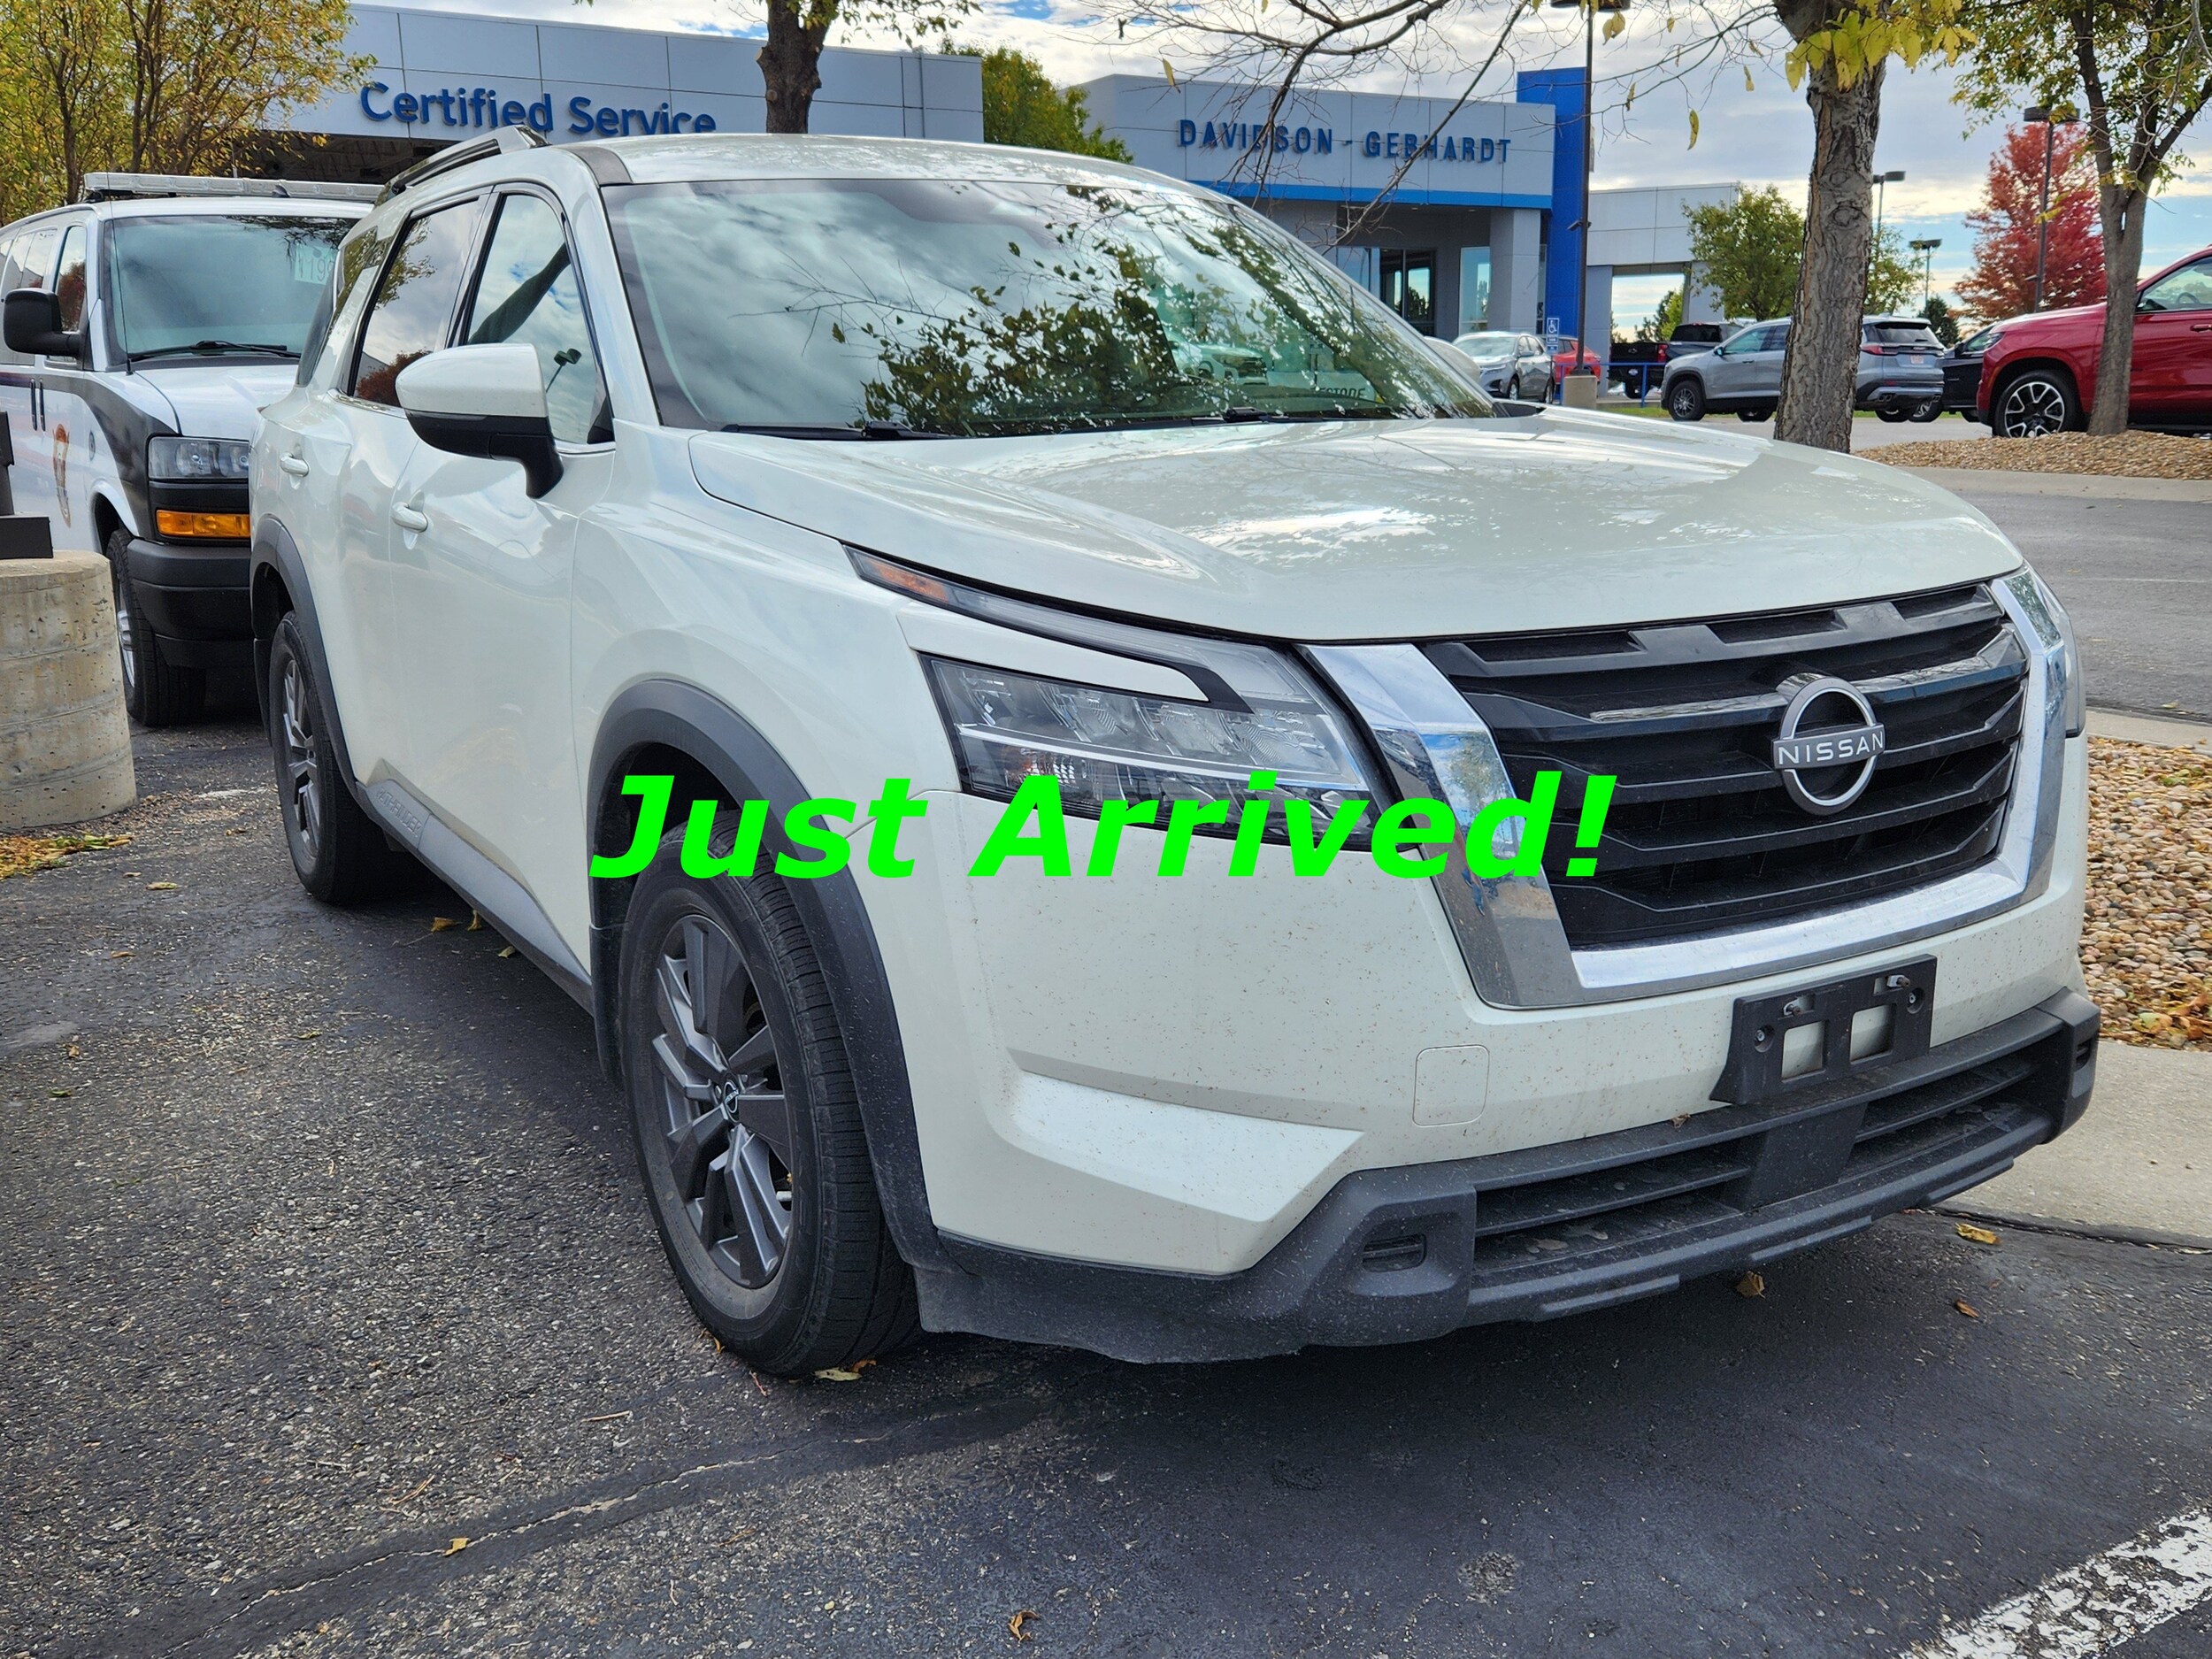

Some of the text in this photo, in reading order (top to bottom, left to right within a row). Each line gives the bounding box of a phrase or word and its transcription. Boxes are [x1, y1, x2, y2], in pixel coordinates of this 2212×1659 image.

[359, 81, 717, 136] Certified Service
[1176, 119, 1333, 155] DAVIDSON
[1363, 130, 1512, 164] GEBHARDT
[1778, 731, 1884, 765] NISSAN
